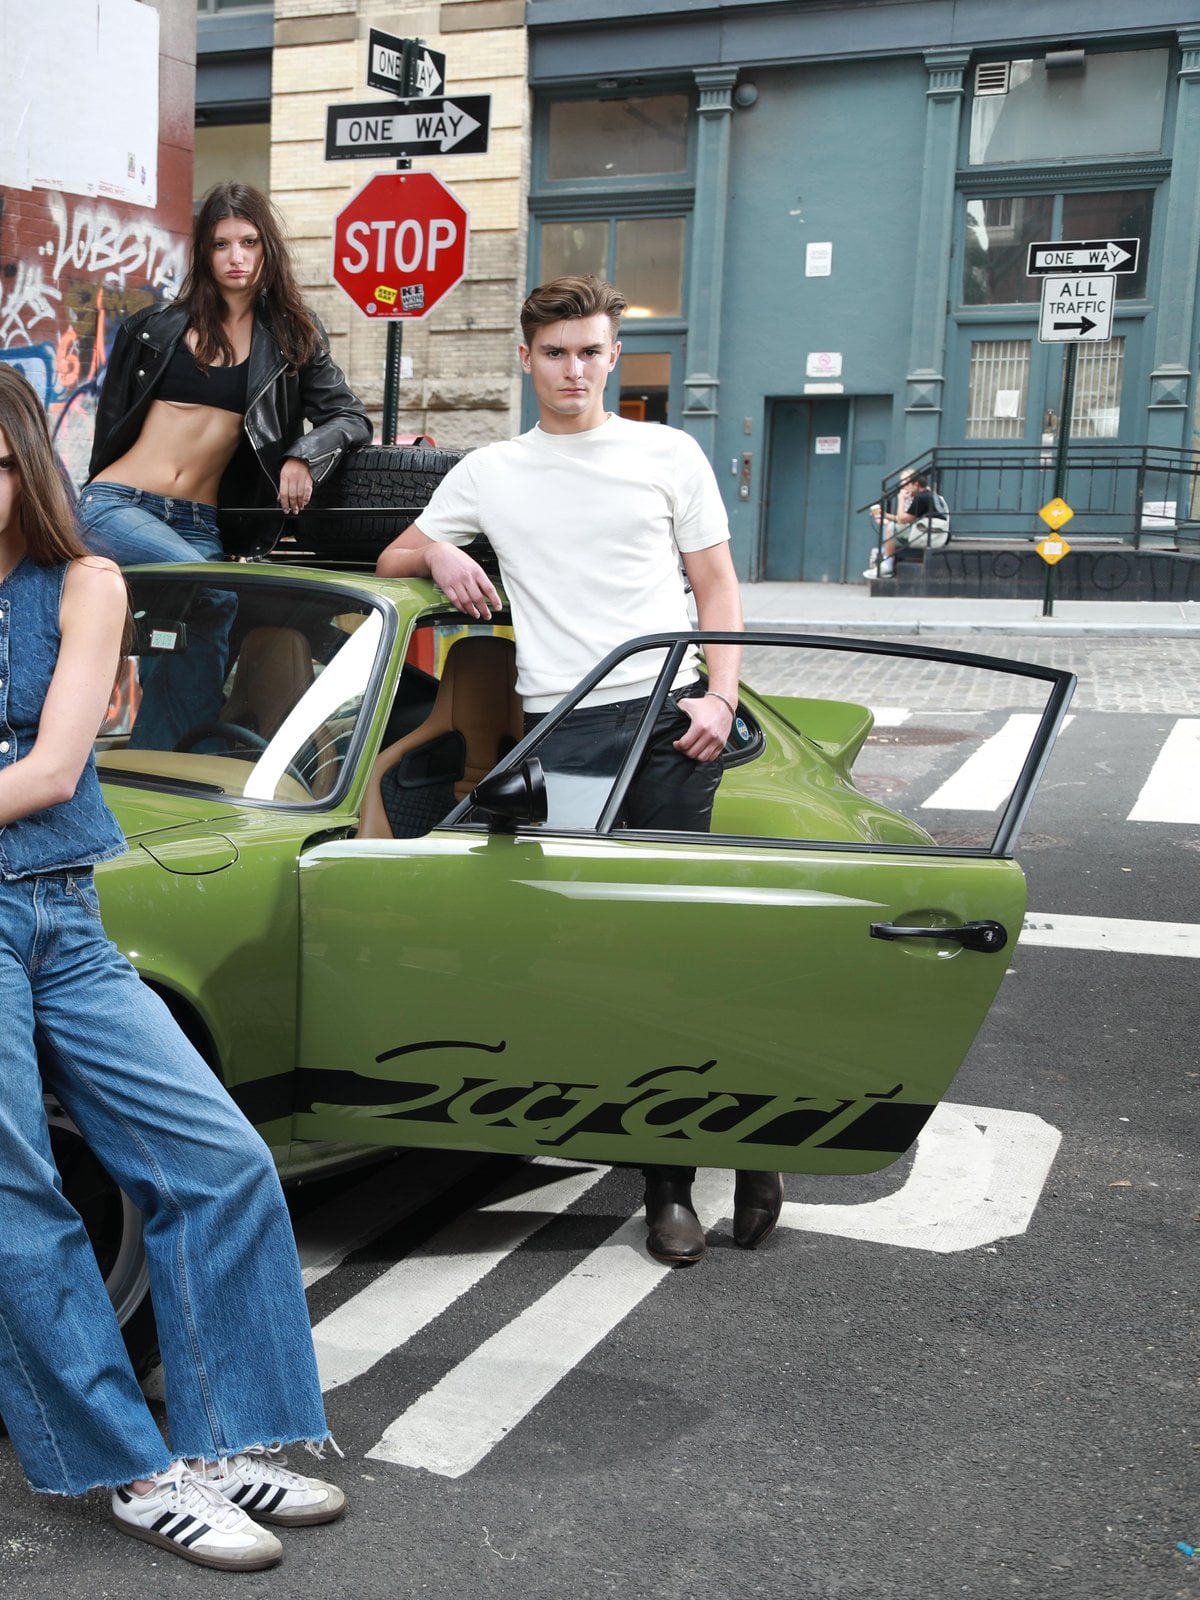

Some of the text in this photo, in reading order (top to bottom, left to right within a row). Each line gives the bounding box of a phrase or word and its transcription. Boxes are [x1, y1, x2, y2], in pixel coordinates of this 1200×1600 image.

[379, 50, 434, 88] ONE AY
[348, 115, 464, 142] ONE WAY
[342, 218, 457, 274] STOP
[1044, 250, 1121, 265] ONE WAY
[1060, 281, 1098, 297] ALL
[1049, 300, 1106, 314] TRAFFIC
[311, 1040, 903, 1148] Safari
